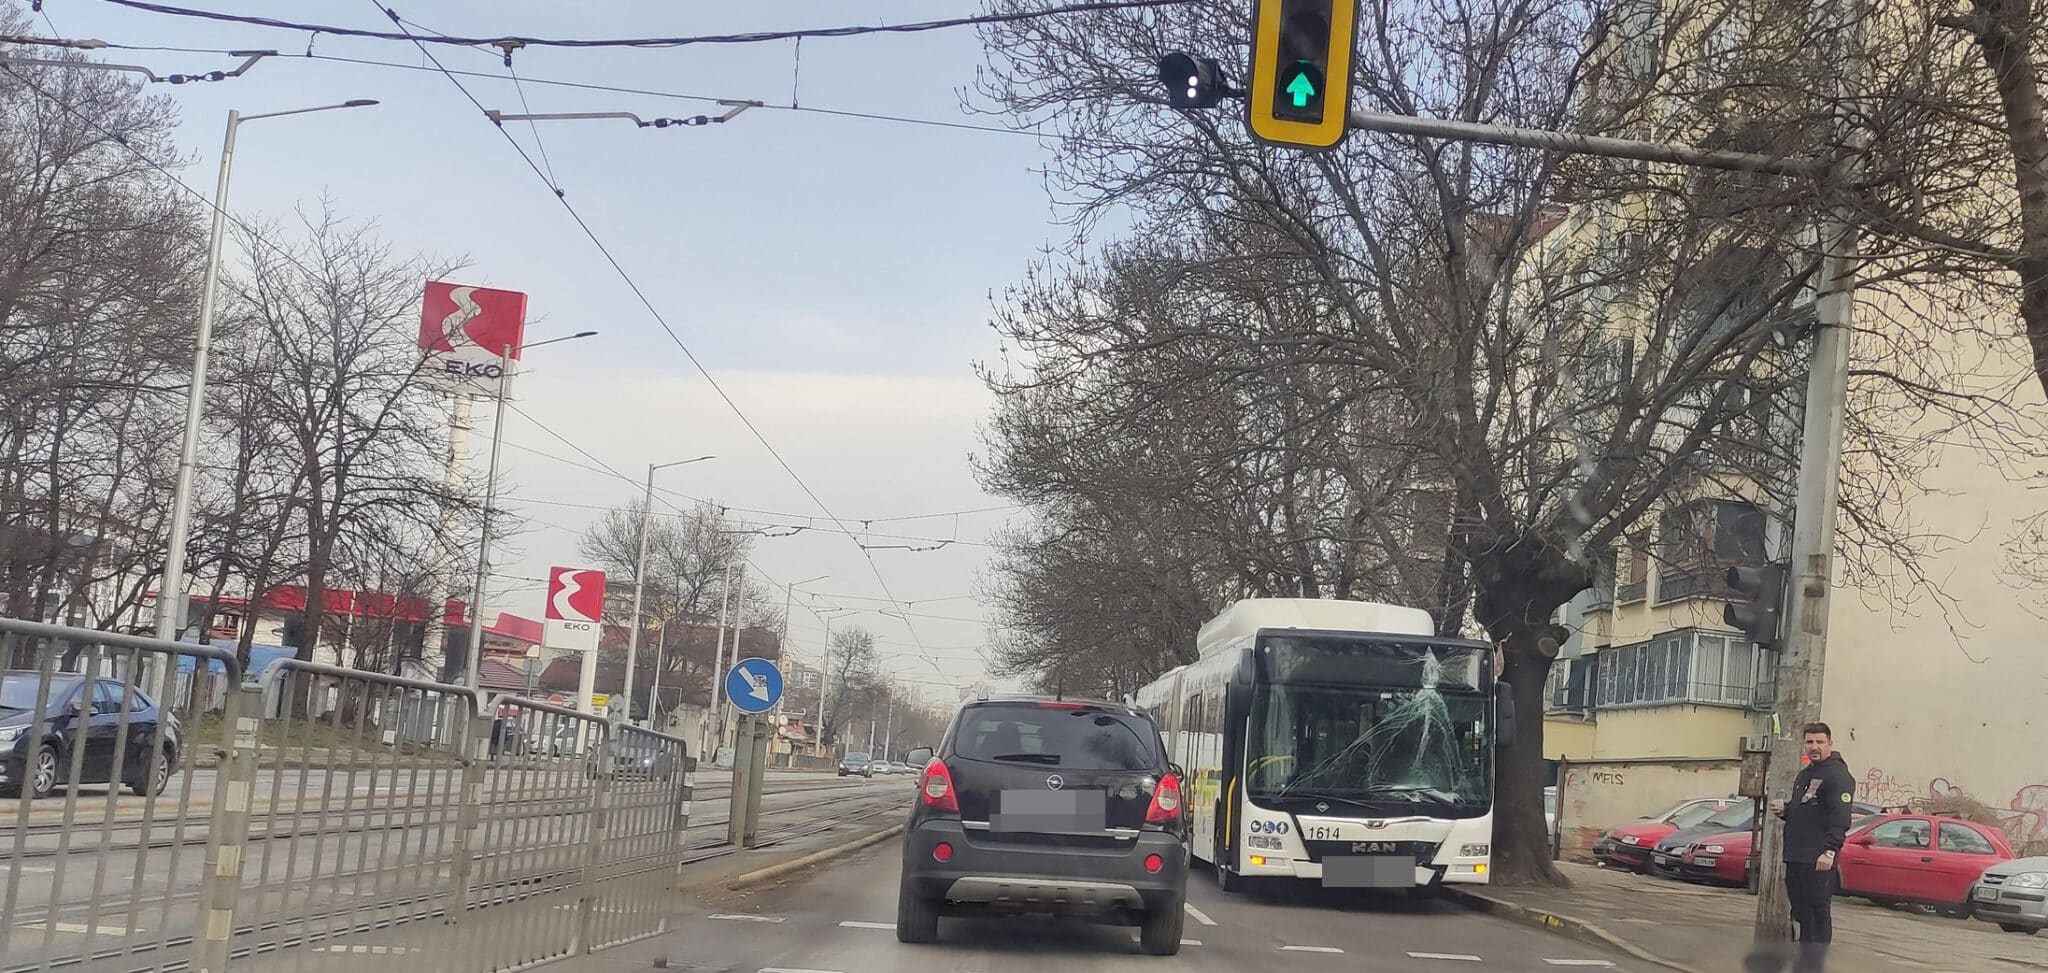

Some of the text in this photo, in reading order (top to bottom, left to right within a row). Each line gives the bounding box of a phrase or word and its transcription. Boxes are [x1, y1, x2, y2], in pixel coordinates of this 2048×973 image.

[446, 360, 503, 377] EKO
[564, 623, 590, 631] EKO
[1308, 826, 1340, 840] 1614
[1351, 842, 1396, 853] MAN
